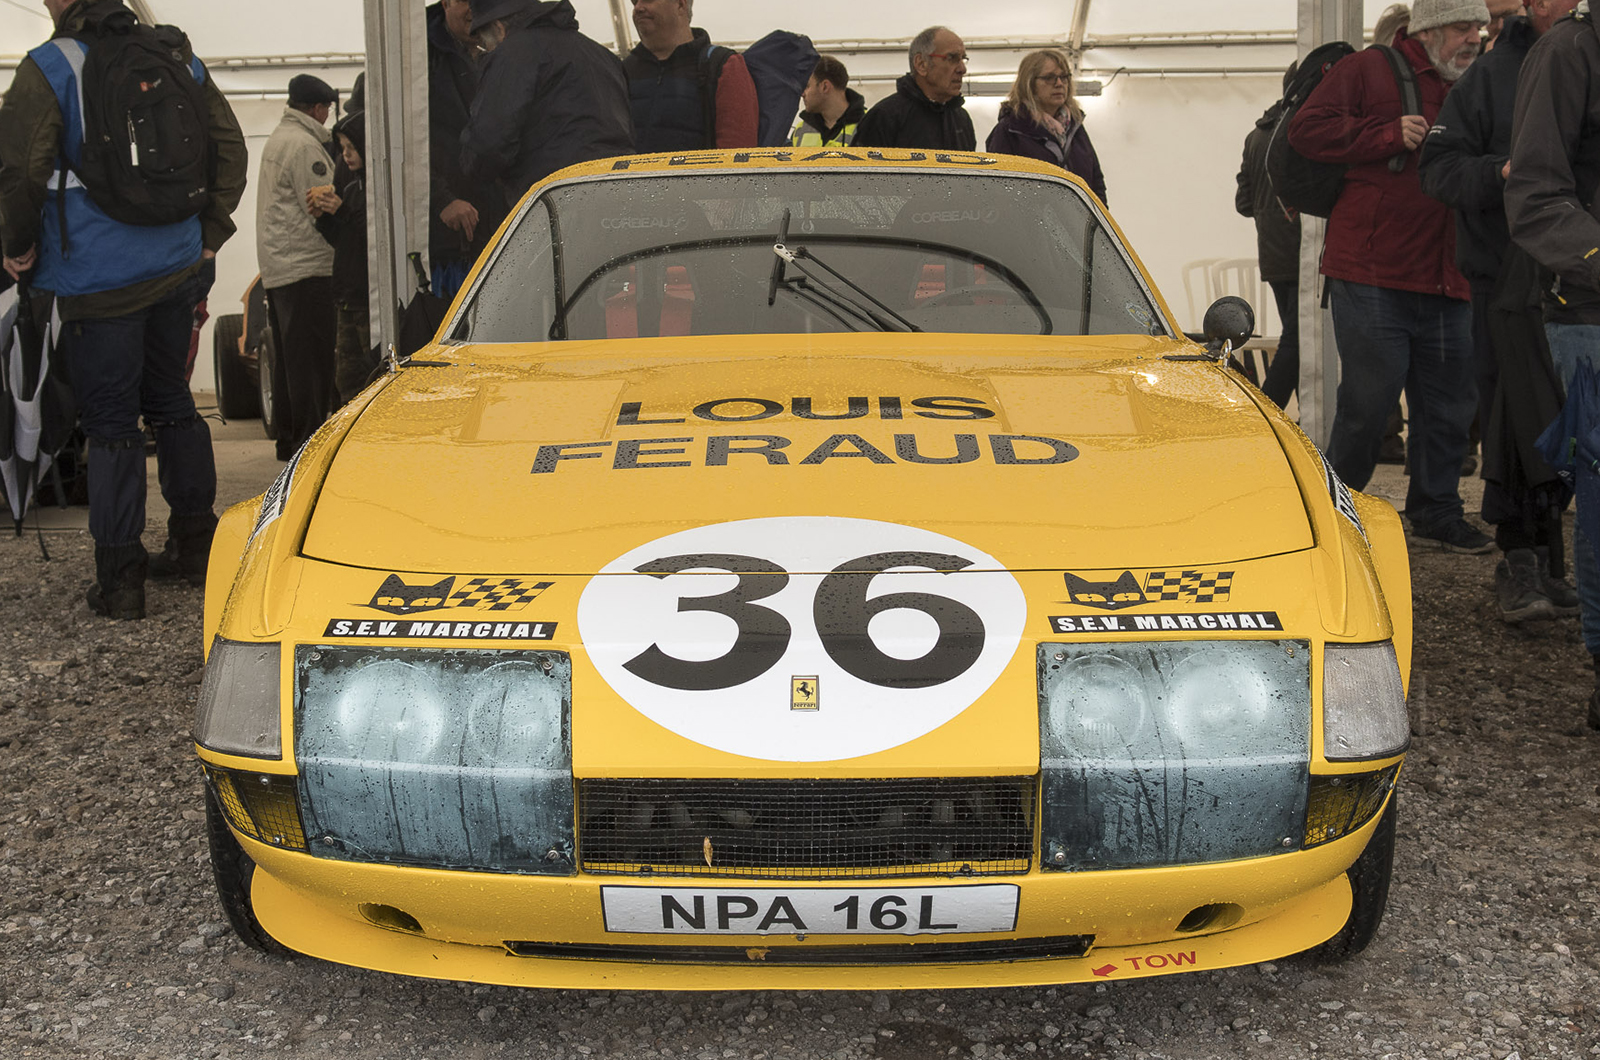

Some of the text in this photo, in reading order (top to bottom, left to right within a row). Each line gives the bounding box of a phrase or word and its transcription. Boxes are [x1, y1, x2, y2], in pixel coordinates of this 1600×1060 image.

[610, 151, 998, 171] FERAUD
[616, 396, 996, 426] LOUIS
[530, 433, 1079, 474] FERAUD
[332, 620, 547, 638] S.E.V. MARCHAL
[621, 551, 987, 690] 36
[1057, 613, 1275, 632] S.E.V. MARCHAL
[660, 895, 958, 931] NPA 16L
[1124, 951, 1197, 971] TOW
